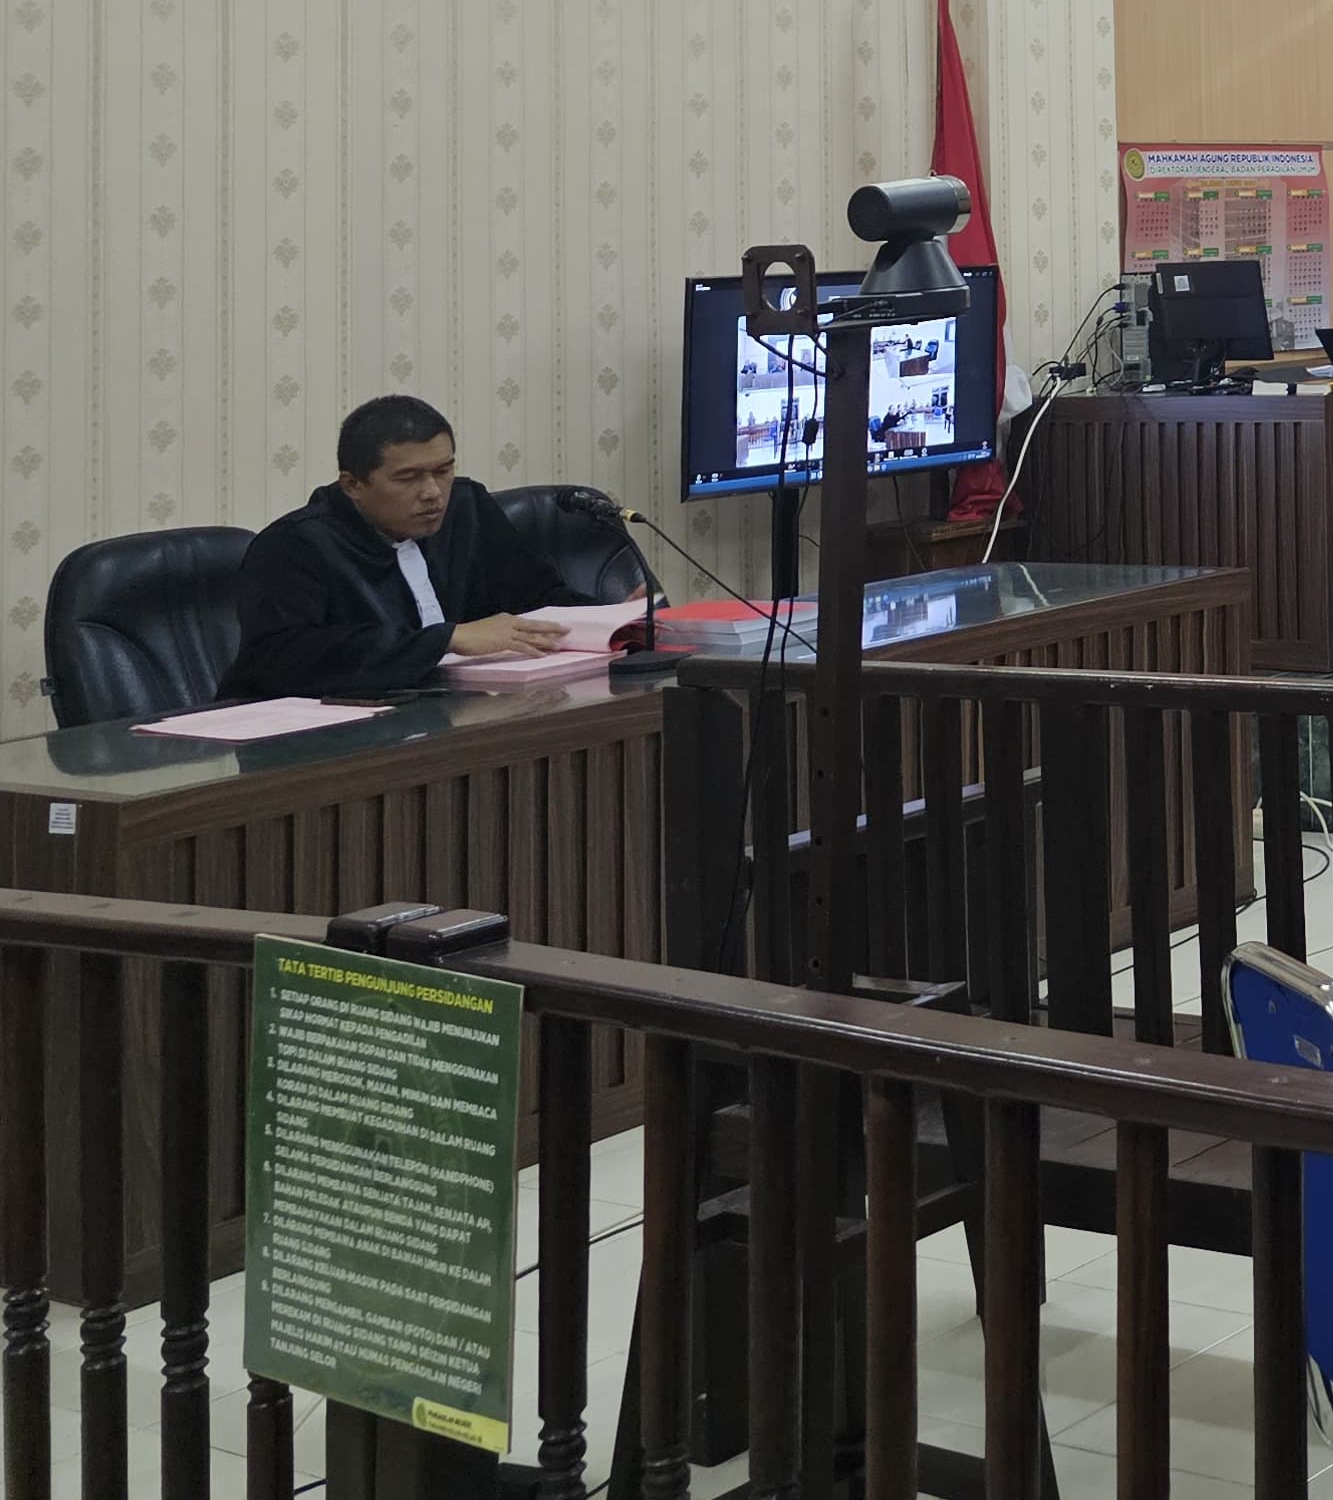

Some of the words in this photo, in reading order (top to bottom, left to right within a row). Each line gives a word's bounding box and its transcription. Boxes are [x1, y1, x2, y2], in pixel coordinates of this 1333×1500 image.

[1148, 154, 1198, 163] MAHKAMAH
[1200, 154, 1230, 163] AGUNG
[1230, 154, 1270, 163] REPUBLIK
[1271, 155, 1313, 164] INDONESIA
[278, 958, 306, 976] TATA
[308, 963, 345, 983] TERTIB
[346, 971, 415, 998] PENGUNJUNG
[416, 986, 494, 1014] PERSIDANGAN
[414, 1016, 441, 1033] WAJIB
[441, 1022, 500, 1047] MENUNJUKAN
[408, 1053, 431, 1070] TIDAK
[431, 1059, 499, 1084] MENGGUNAKAN
[401, 1087, 430, 1104] MINUM
[430, 1095, 452, 1110] DAN
[453, 1099, 497, 1120] MEMBACA
[430, 1130, 463, 1148] DALAM
[464, 1138, 496, 1157] RUANG
[430, 1166, 495, 1194] (HANDPHONE)
[433, 1206, 475, 1227] SENJATA
[406, 1235, 439, 1255] SIDANG
[415, 1219, 439, 1236] YANG
[439, 1226, 472, 1244] DAPAT
[424, 1257, 448, 1275] UMUR
[461, 1267, 492, 1287] DALAM
[404, 1287, 428, 1304] SAAT
[428, 1294, 492, 1324] PERSIDANGAN
[404, 1323, 436, 1344] (FOTO)
[436, 1333, 458, 1349] DAN
[465, 1341, 491, 1359] ATAU
[448, 1355, 481, 1375] KETUA
[447, 1374, 483, 1395] NEGERI
